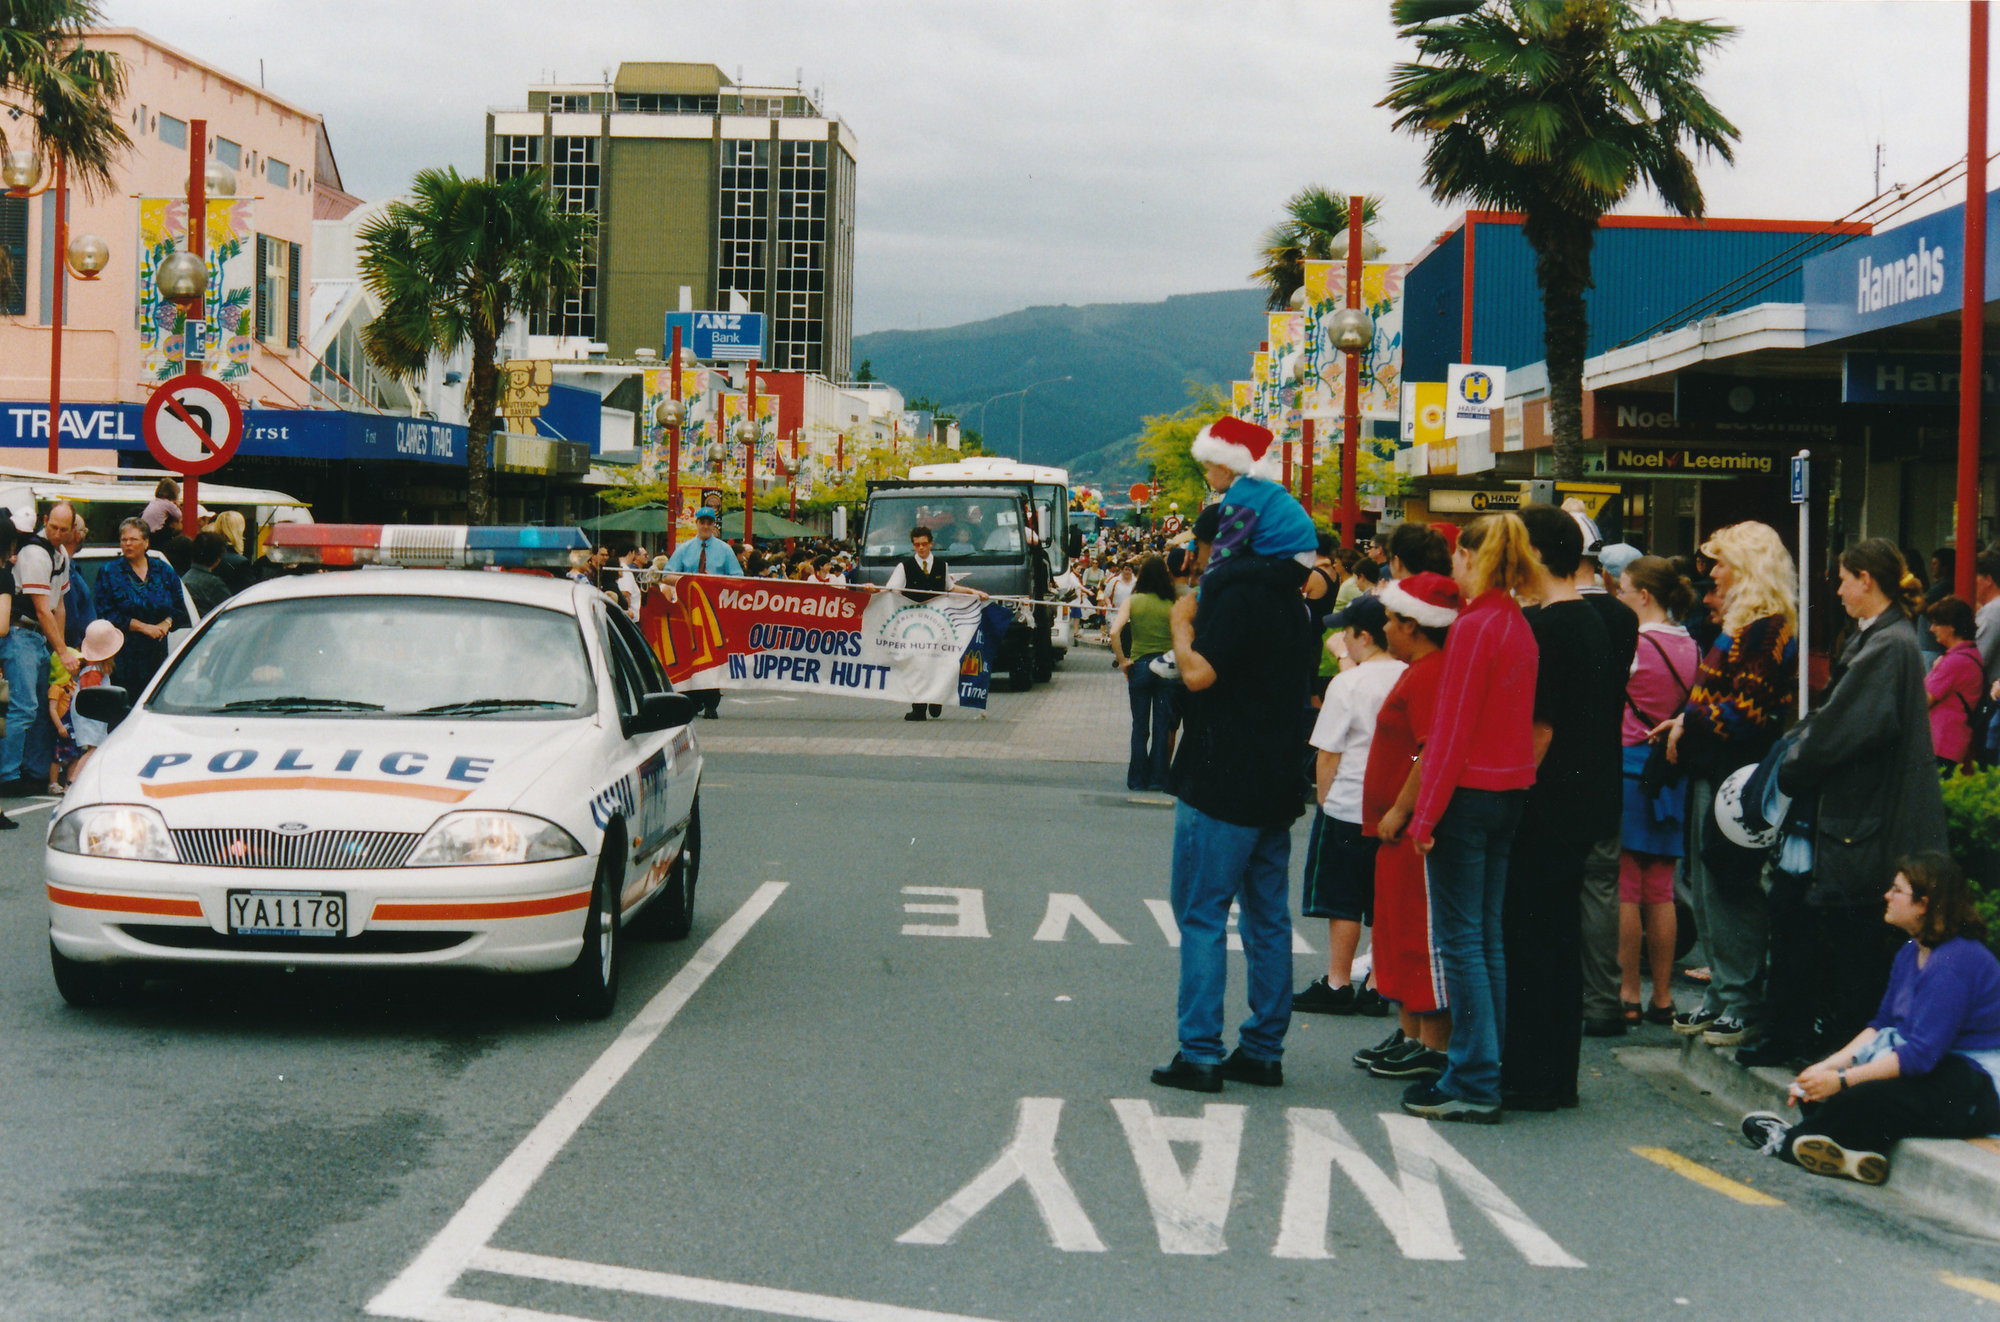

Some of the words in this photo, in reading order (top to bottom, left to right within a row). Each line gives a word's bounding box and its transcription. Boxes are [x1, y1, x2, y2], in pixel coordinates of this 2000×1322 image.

[1857, 237, 1945, 314] Hannahs
[195, 323, 206, 338] P
[697, 315, 741, 329] ANZ
[712, 332, 740, 343] Bank
[8, 408, 136, 441] TRAVEL
[243, 423, 290, 440] irst
[431, 426, 454, 458] TRAVEL
[1617, 450, 1664, 468] Noel
[1683, 451, 1773, 472] Leeming
[718, 588, 857, 619] McDonald's
[749, 622, 864, 658] OUTDOORS
[875, 639, 906, 650] UPPER
[910, 642, 938, 650] HUTT
[941, 644, 963, 652] CITY
[727, 652, 747, 680] IN
[753, 654, 821, 684] UPPER
[830, 660, 891, 690] HUTT
[960, 682, 987, 700] Time
[137, 748, 495, 784] POLICE
[234, 897, 341, 928] YA1178
[895, 1097, 1589, 1268] WAY
